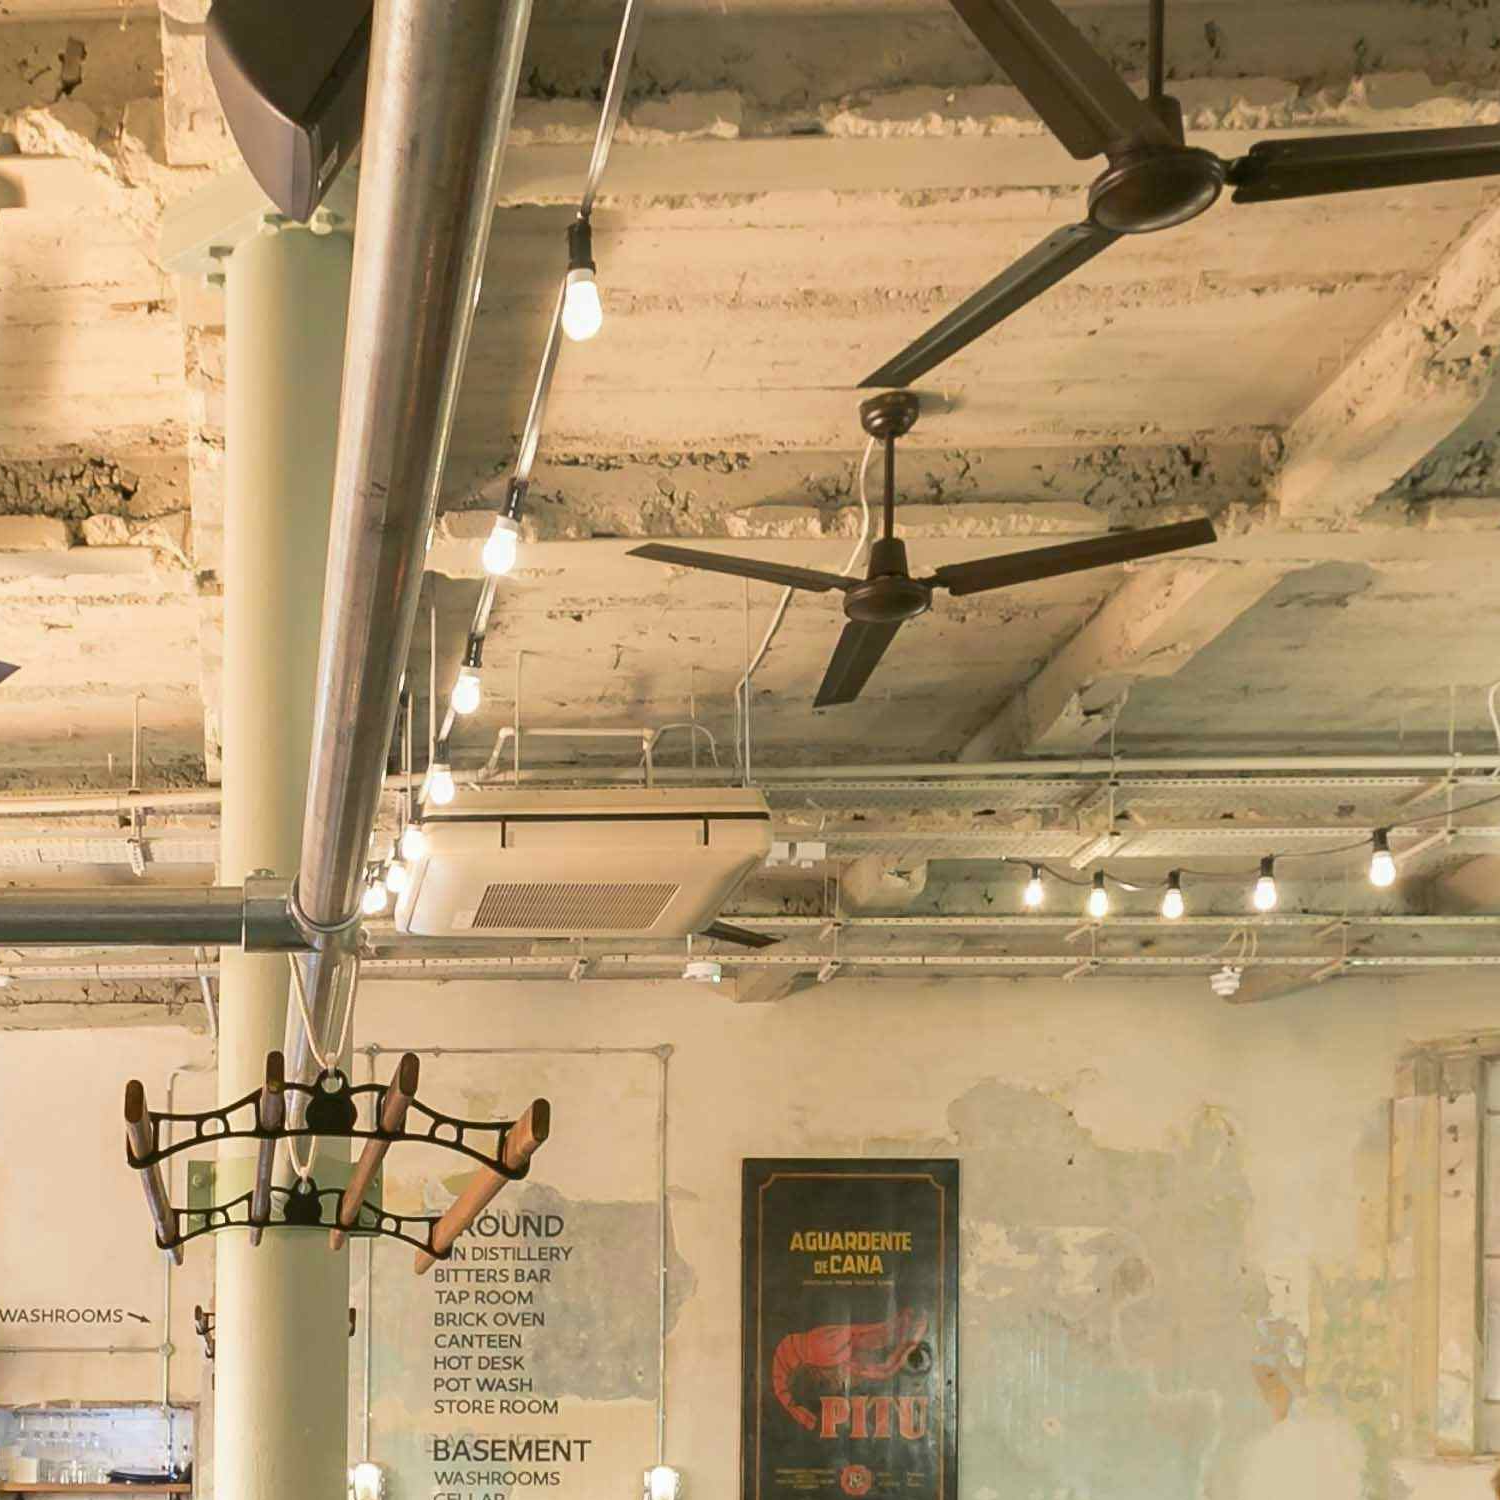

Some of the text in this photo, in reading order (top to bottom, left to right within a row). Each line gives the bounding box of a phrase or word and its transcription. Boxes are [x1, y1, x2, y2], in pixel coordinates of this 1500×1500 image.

[463, 1214, 564, 1238] OUND
[789, 1231, 912, 1252] AGUARDENTE
[471, 1246, 573, 1261] DISTILLERY
[814, 1255, 884, 1275] DE CANA
[434, 1268, 552, 1283] BITTERS BAR
[435, 1290, 534, 1305] TAP ROOM
[434, 1312, 546, 1328] BRICK OVEN
[434, 1334, 523, 1349] CANTEEN
[434, 1355, 526, 1371] HOT DESK
[434, 1377, 533, 1393] POT WASH
[433, 1399, 559, 1415] STORE ROOM
[432, 1439, 592, 1463] BASEMENT
[434, 1470, 561, 1487] WASHROOMS
